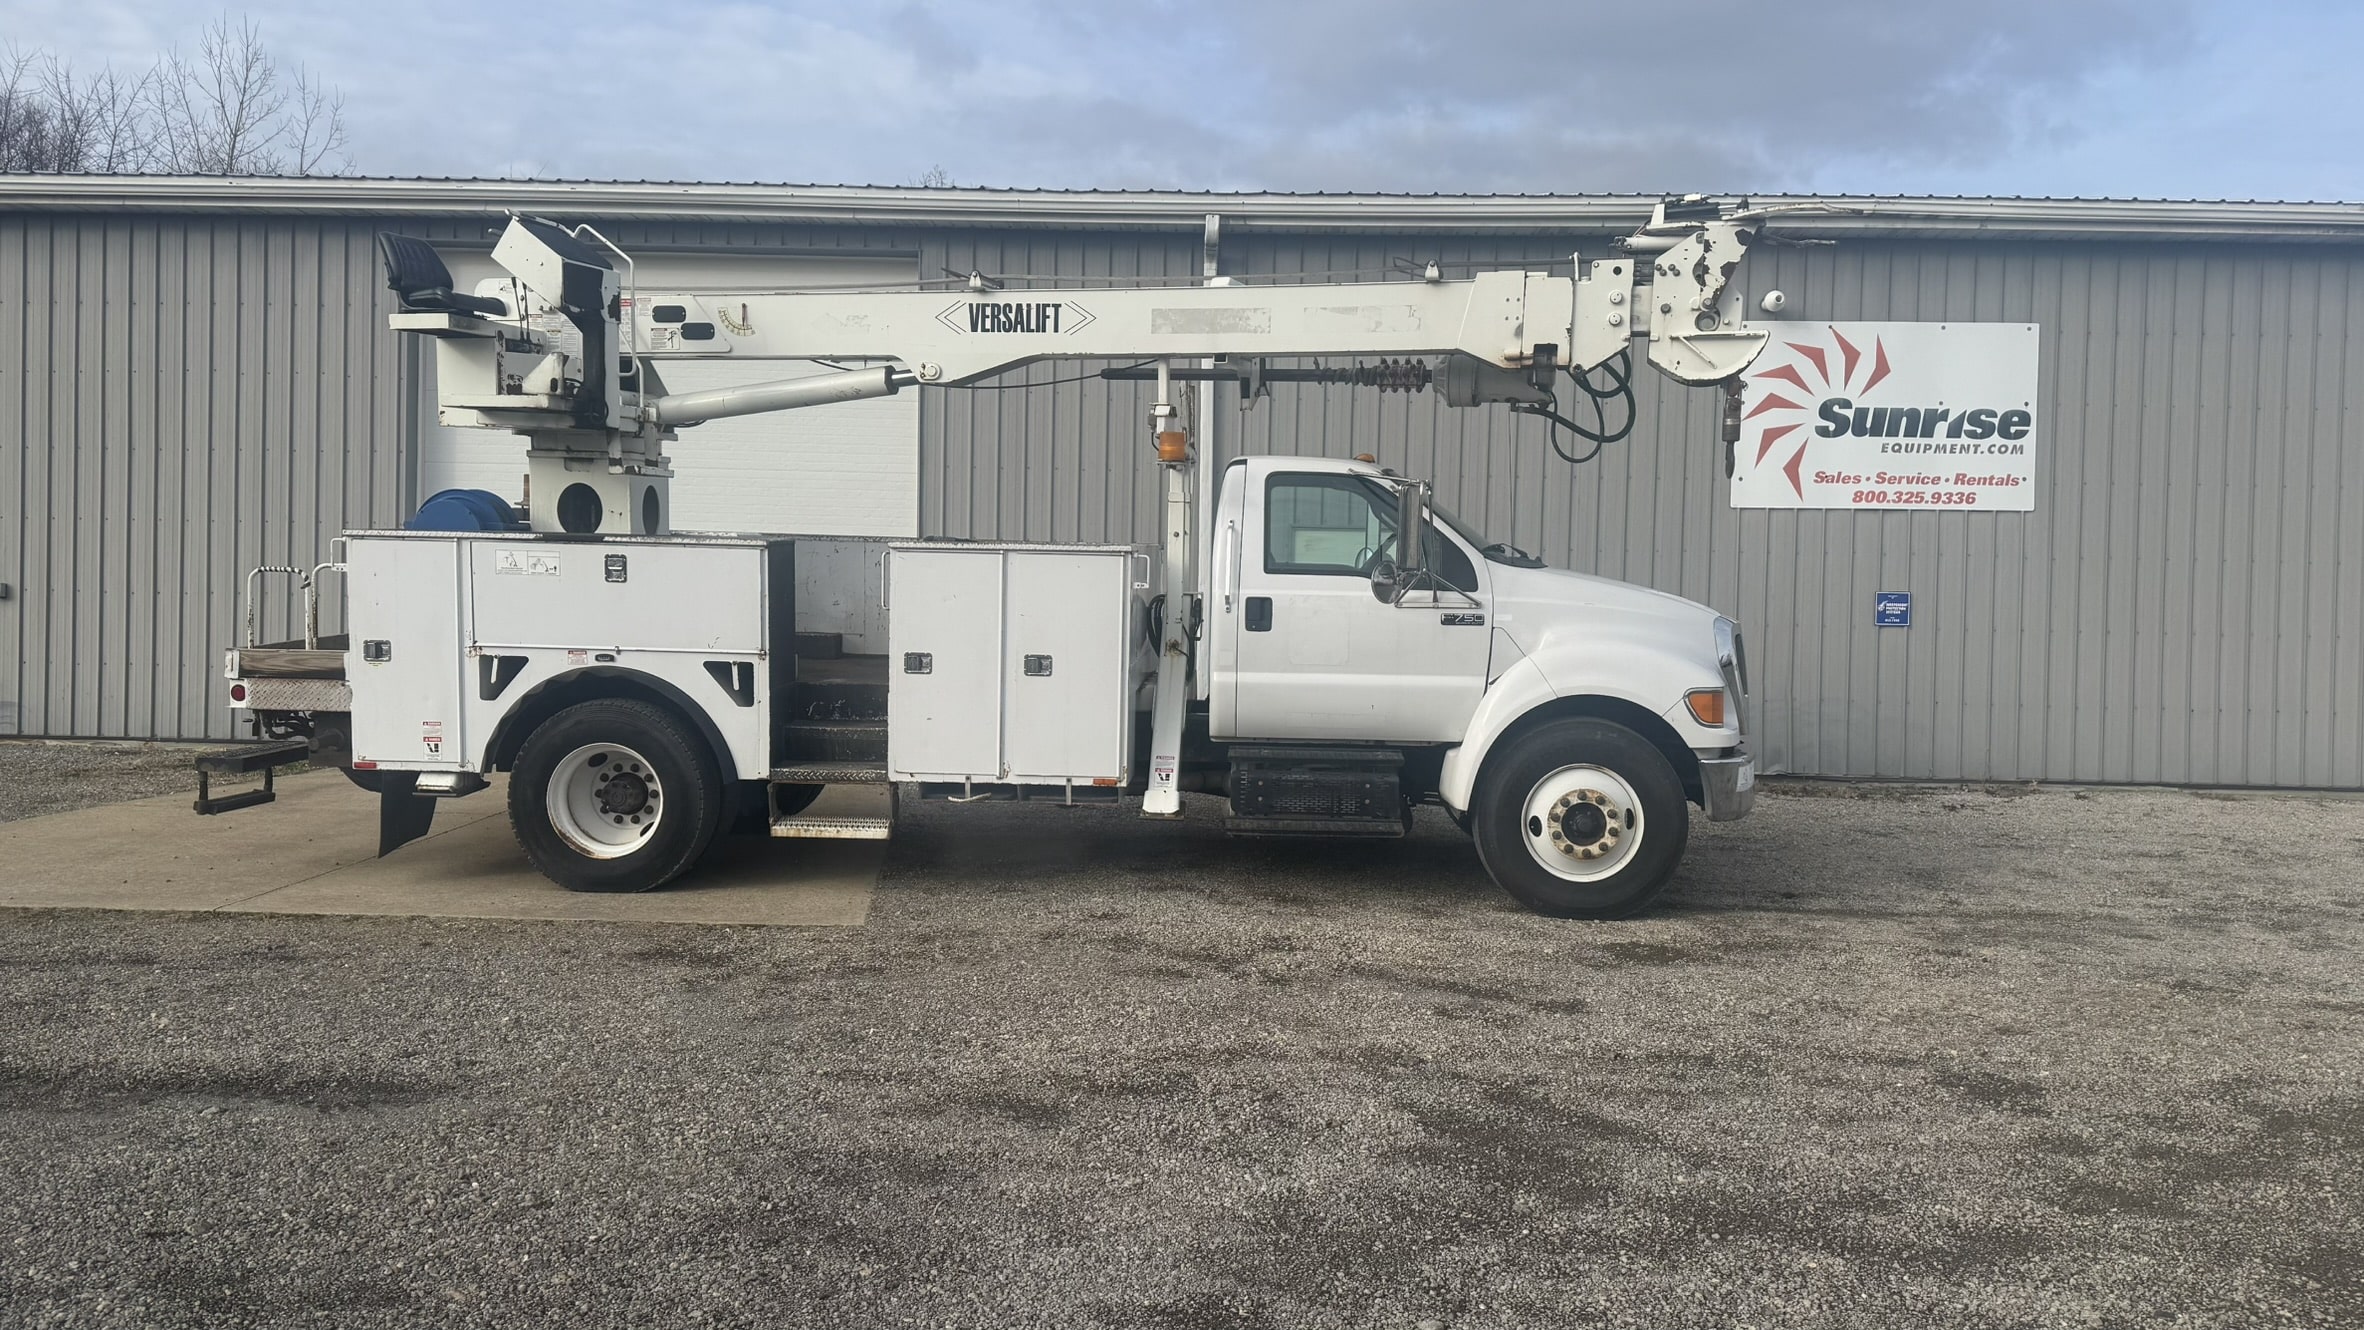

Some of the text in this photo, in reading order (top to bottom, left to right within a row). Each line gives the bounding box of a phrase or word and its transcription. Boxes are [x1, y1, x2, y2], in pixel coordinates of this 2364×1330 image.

[968, 303, 1062, 333] VERSALIFT
[1814, 397, 2031, 440] Sunrise
[1880, 442, 2025, 455] EQUIPMENT.COM
[1813, 471, 2020, 487] Sales Service Rentals
[1851, 490, 1977, 505] 800.325.9336
